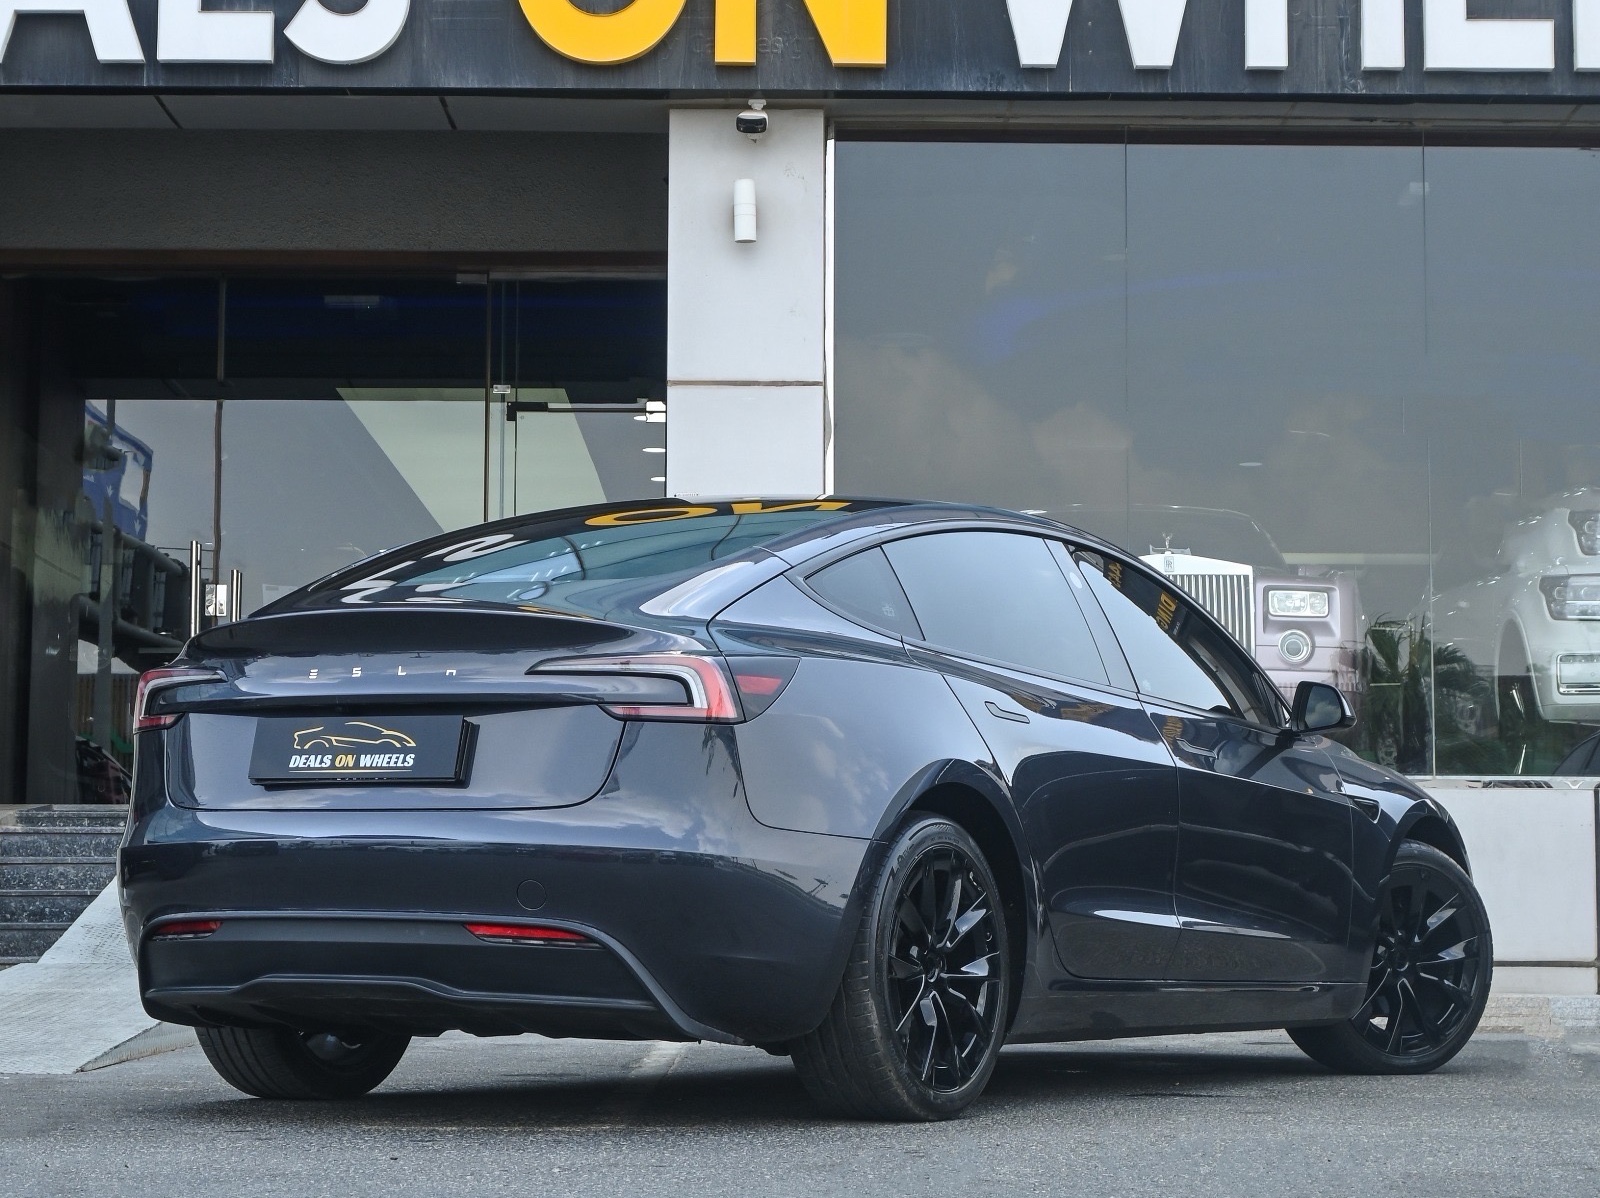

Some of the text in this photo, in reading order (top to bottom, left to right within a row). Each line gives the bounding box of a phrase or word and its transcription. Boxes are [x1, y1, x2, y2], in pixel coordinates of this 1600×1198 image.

[288, 753, 415, 768] DEALS ON WHEELS
